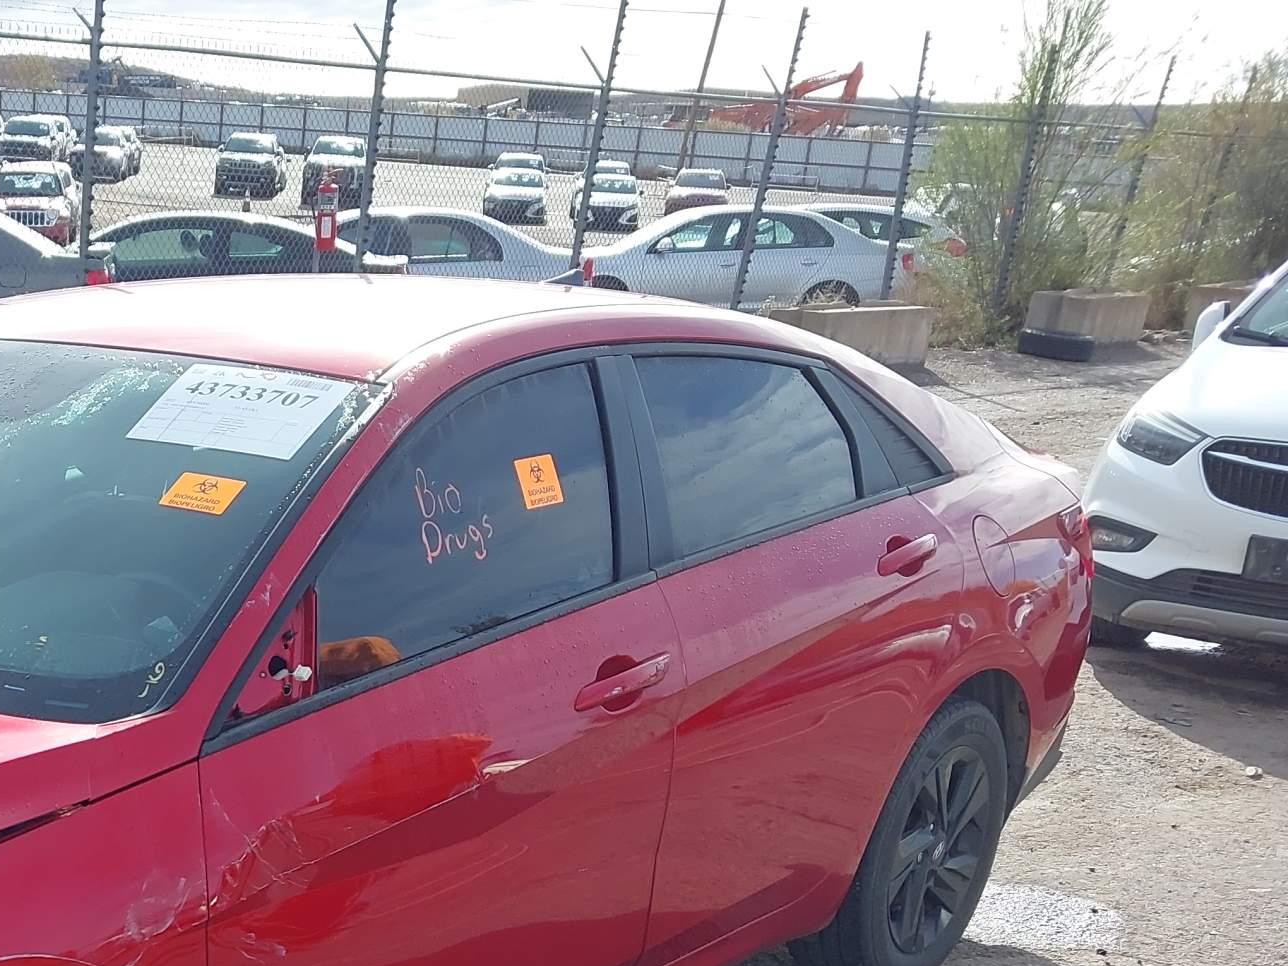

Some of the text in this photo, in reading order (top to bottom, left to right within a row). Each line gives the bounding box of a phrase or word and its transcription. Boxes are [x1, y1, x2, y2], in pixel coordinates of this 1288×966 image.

[185, 380, 319, 409] 43733707
[173, 493, 221, 506] BIOHAZARD
[415, 467, 462, 519] Bio
[528, 485, 556, 497] BIOHAZARD
[168, 499, 217, 511] BIOPELIGRO
[422, 514, 494, 565] Drugs
